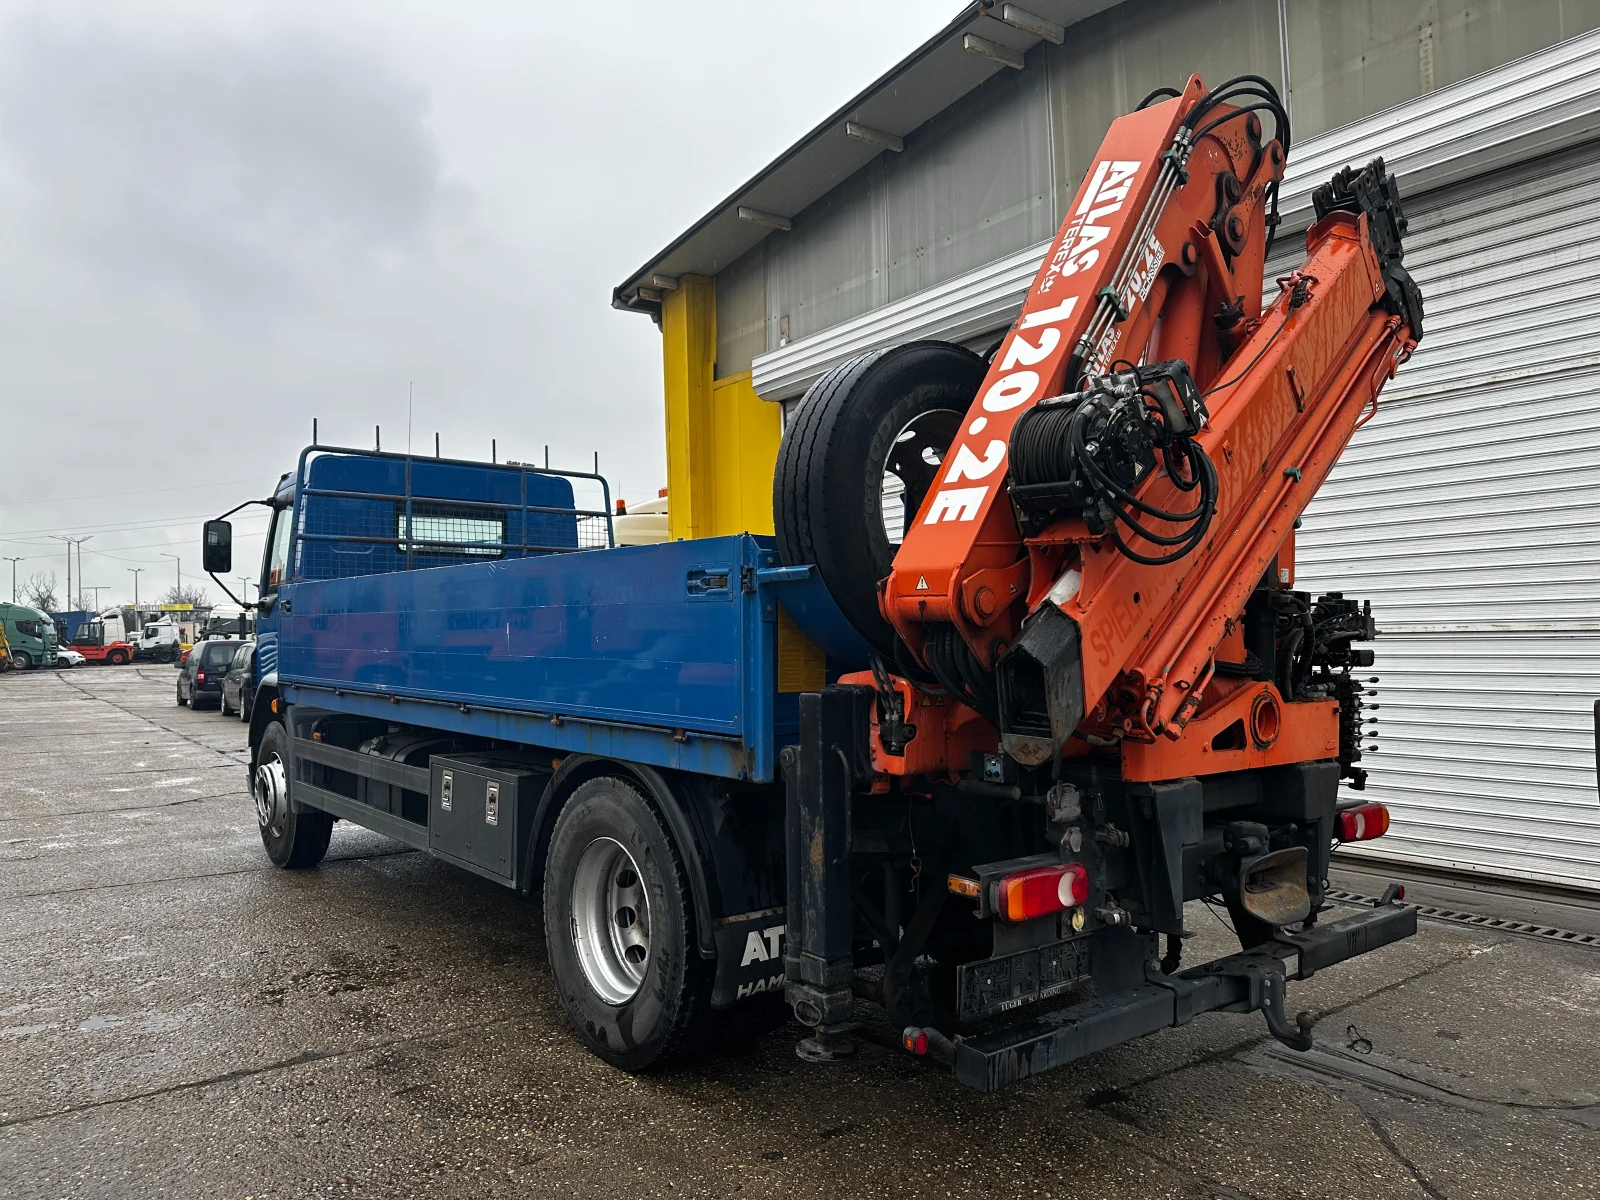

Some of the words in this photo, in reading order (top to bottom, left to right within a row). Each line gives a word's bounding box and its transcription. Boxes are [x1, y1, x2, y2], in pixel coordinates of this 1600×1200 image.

[1062, 160, 1142, 278] ATLAS
[1047, 211, 1088, 278] TEREX
[1102, 336, 1118, 366] TEREX
[921, 295, 1080, 525] 120.2E
[740, 924, 787, 967] AT
[736, 972, 786, 1000] HAM
[1000, 999, 1022, 1011] LUGER
